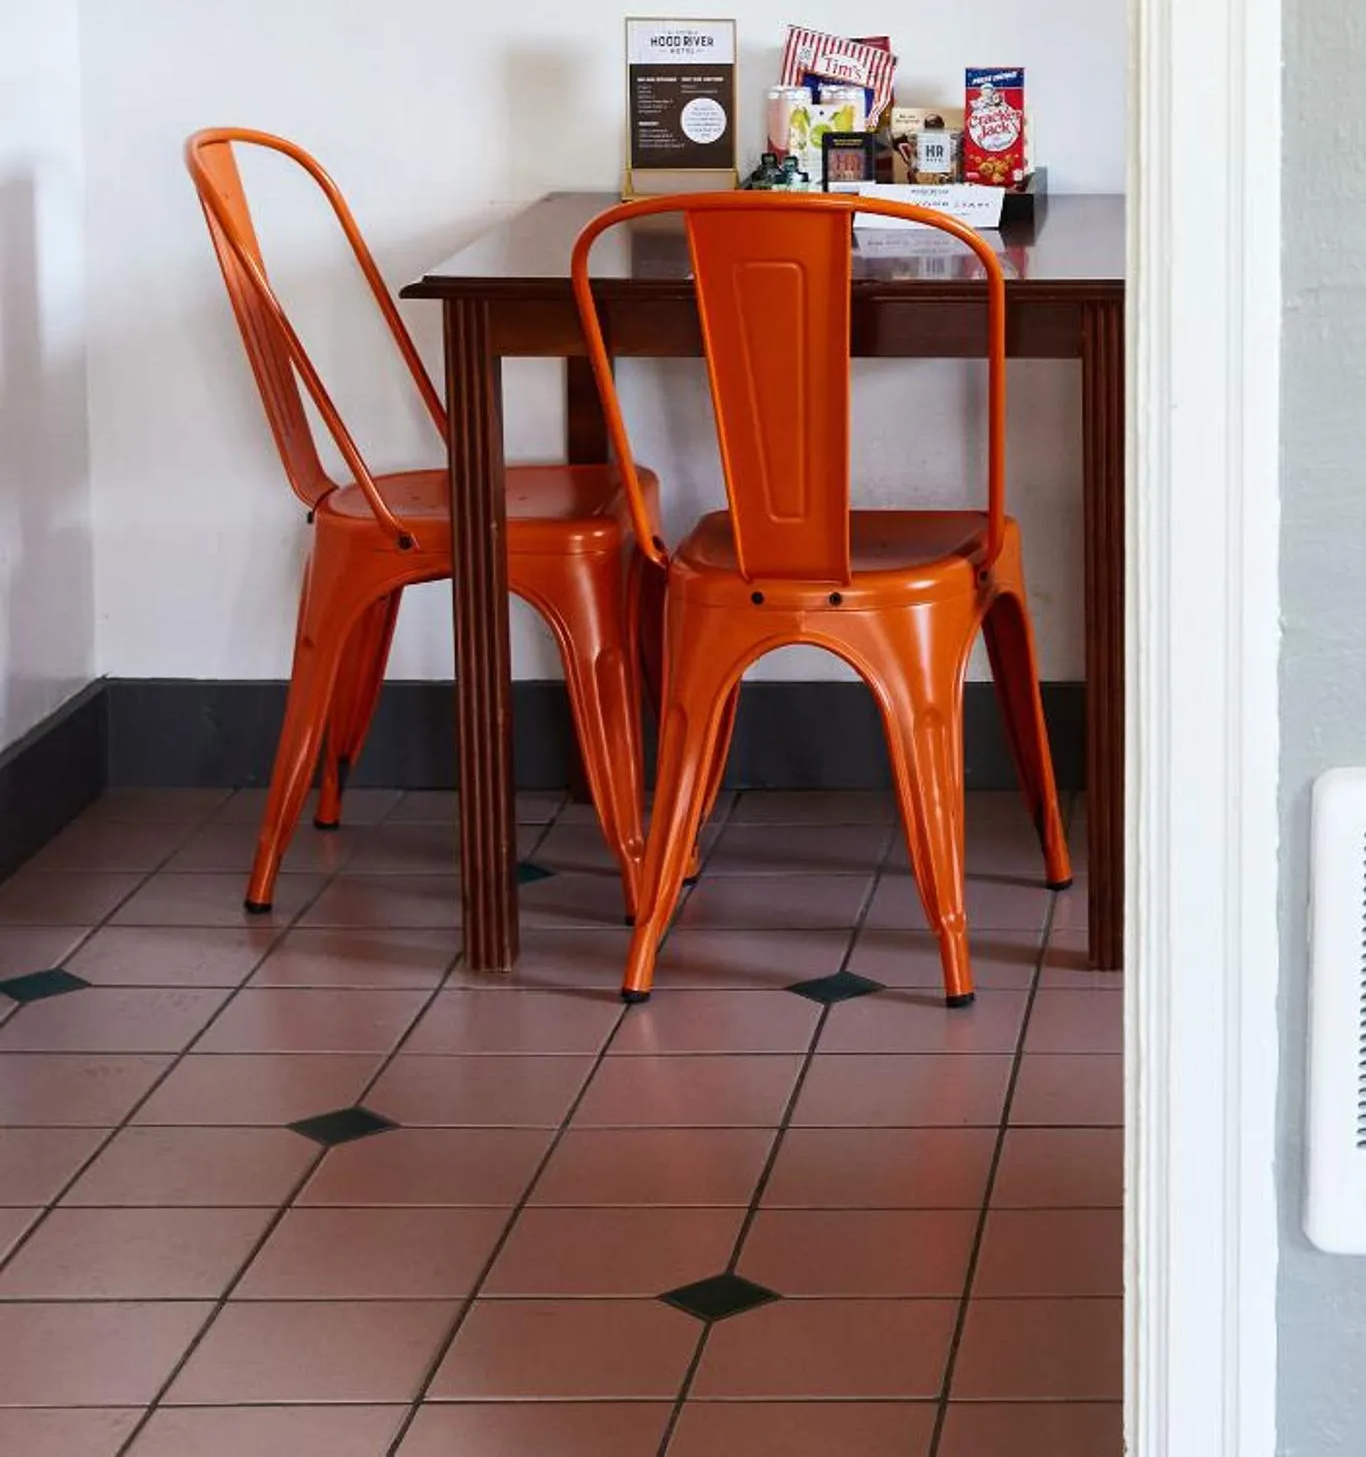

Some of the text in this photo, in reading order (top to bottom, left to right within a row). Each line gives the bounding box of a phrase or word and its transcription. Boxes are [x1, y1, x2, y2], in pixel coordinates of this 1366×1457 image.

[651, 36, 714, 47] HOOD RIVER
[824, 57, 863, 79] Tim's
[970, 109, 1023, 128] Cracker
[979, 123, 1010, 139] Jack
[925, 144, 943, 157] HR
